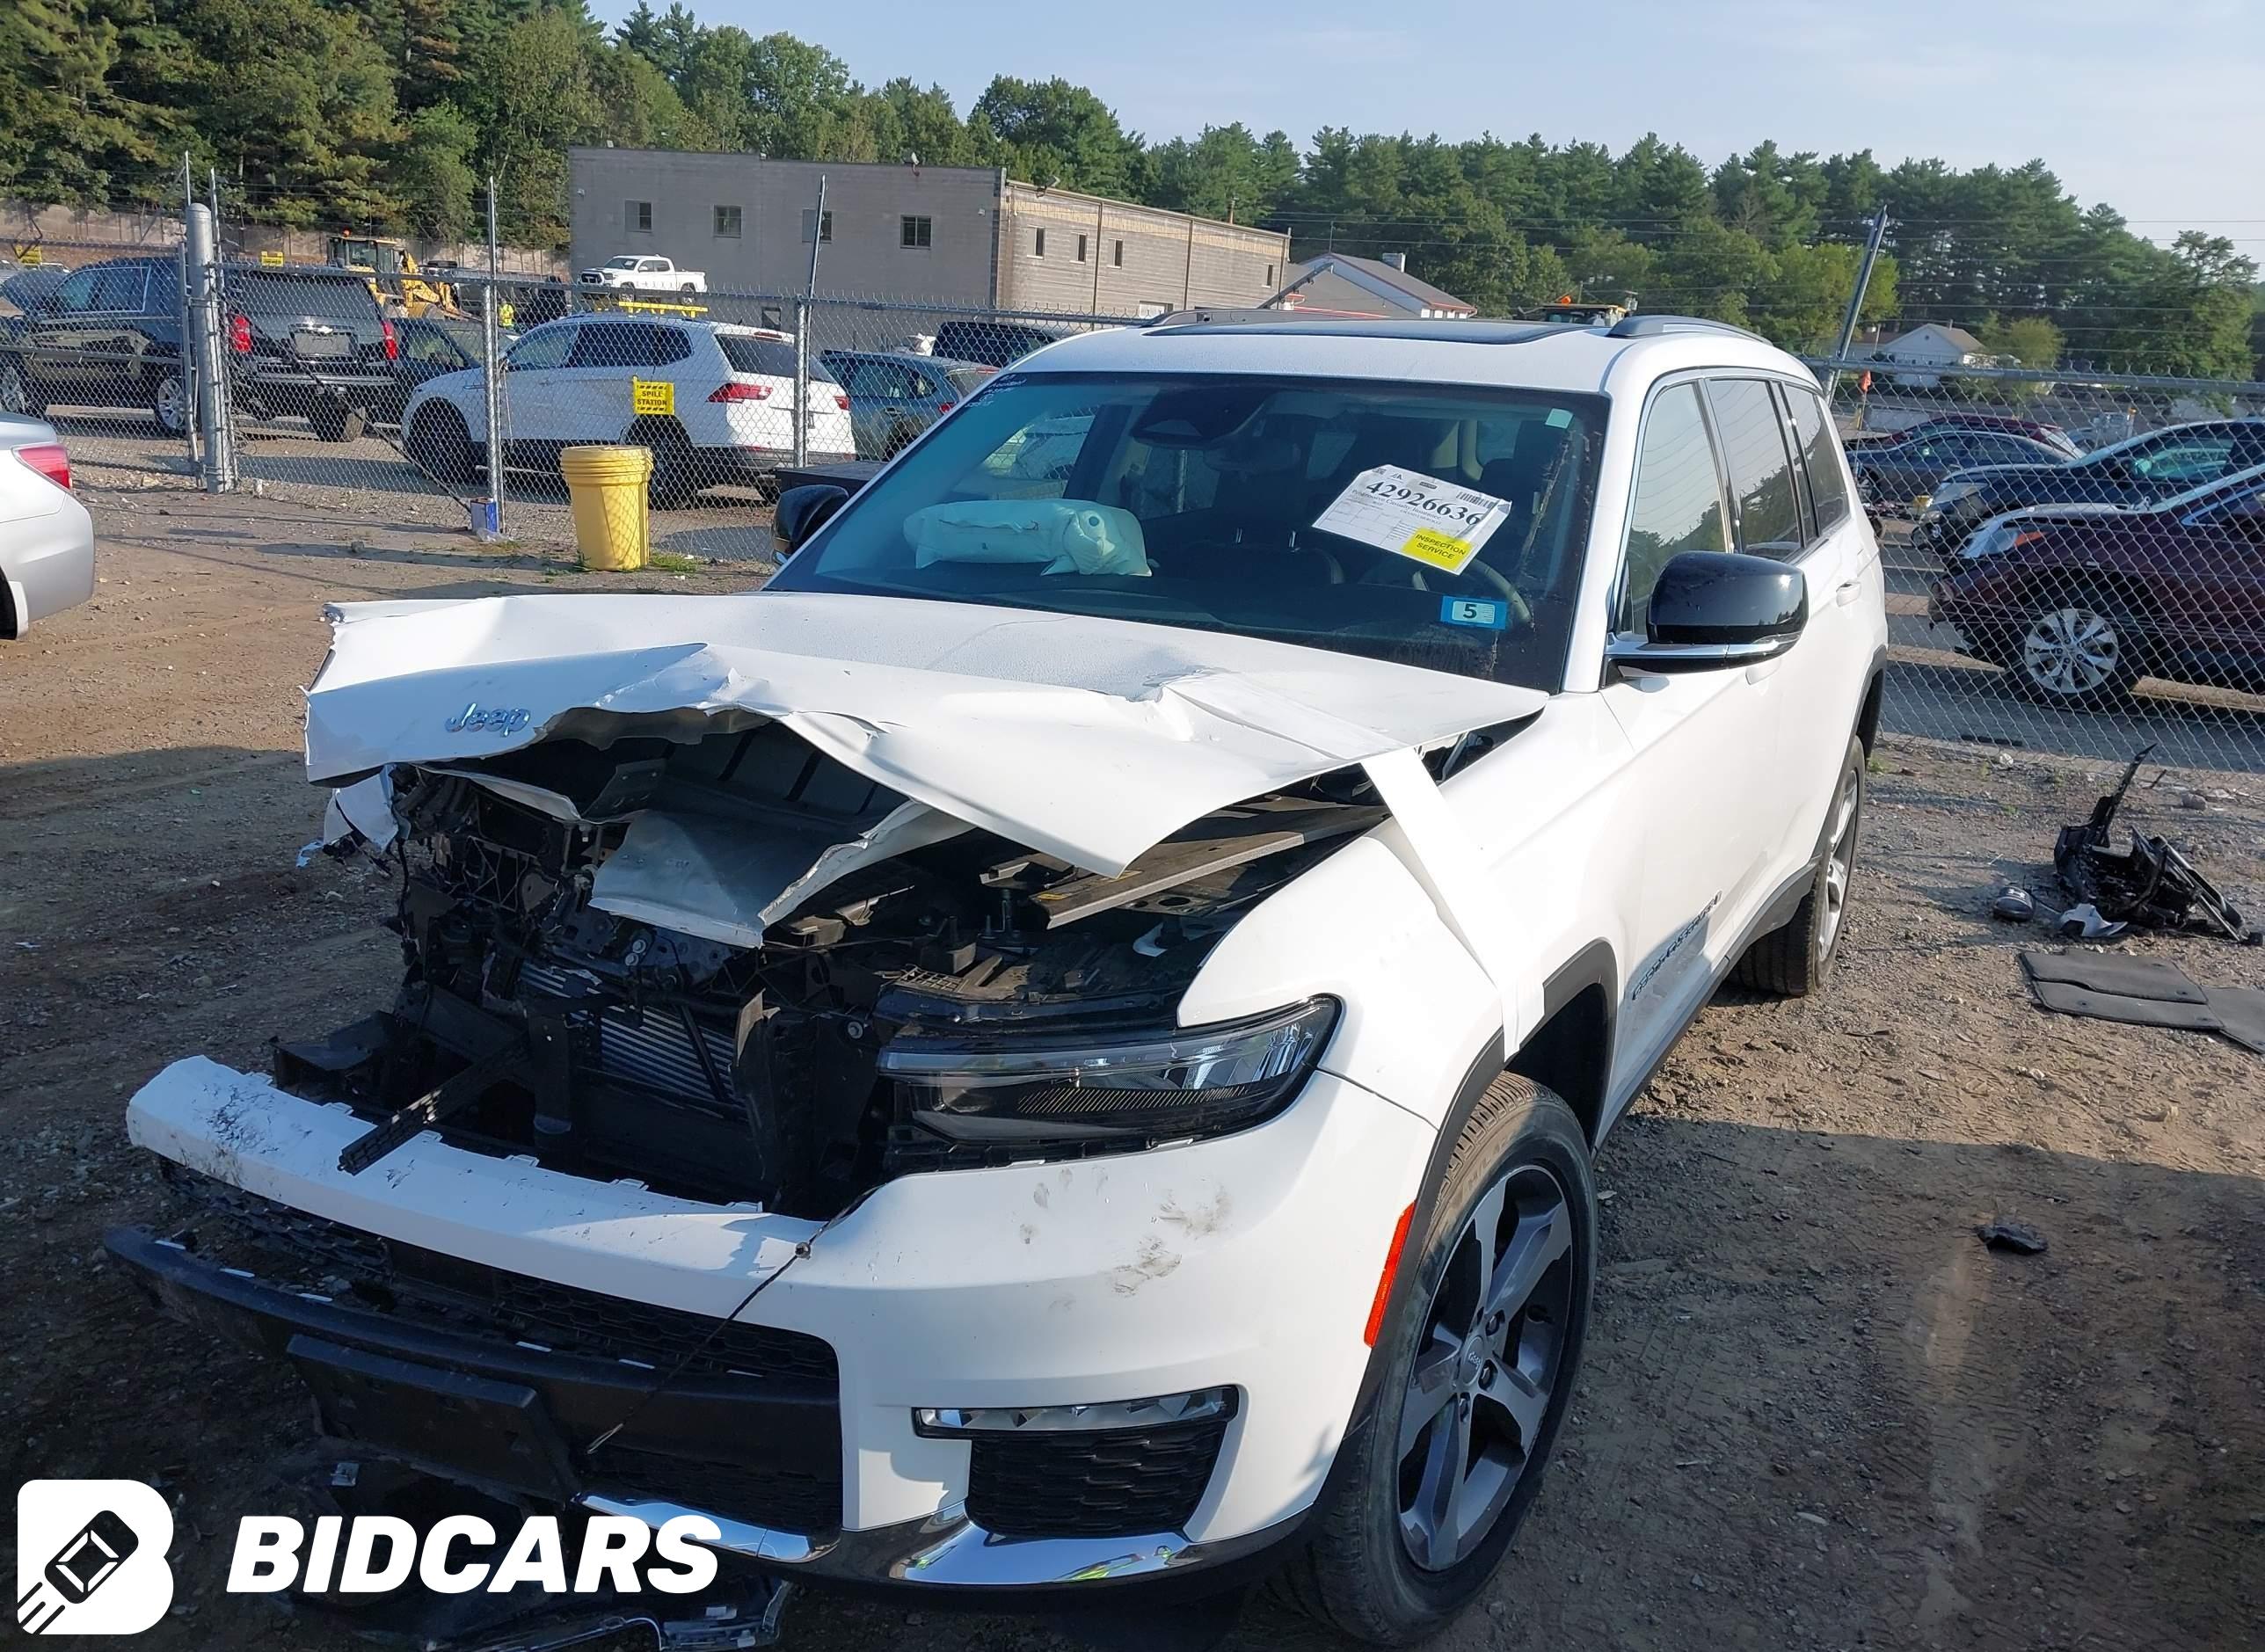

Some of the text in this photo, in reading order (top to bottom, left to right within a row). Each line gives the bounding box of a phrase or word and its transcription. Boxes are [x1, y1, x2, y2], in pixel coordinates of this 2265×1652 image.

[1366, 481, 1483, 525] 42926636
[1412, 506, 1442, 520] Insurance
[1415, 534, 1467, 555] INSPECTION
[1416, 542, 1455, 559] SERVICE
[1462, 603, 1477, 619] 5
[444, 702, 531, 738] Jeep
